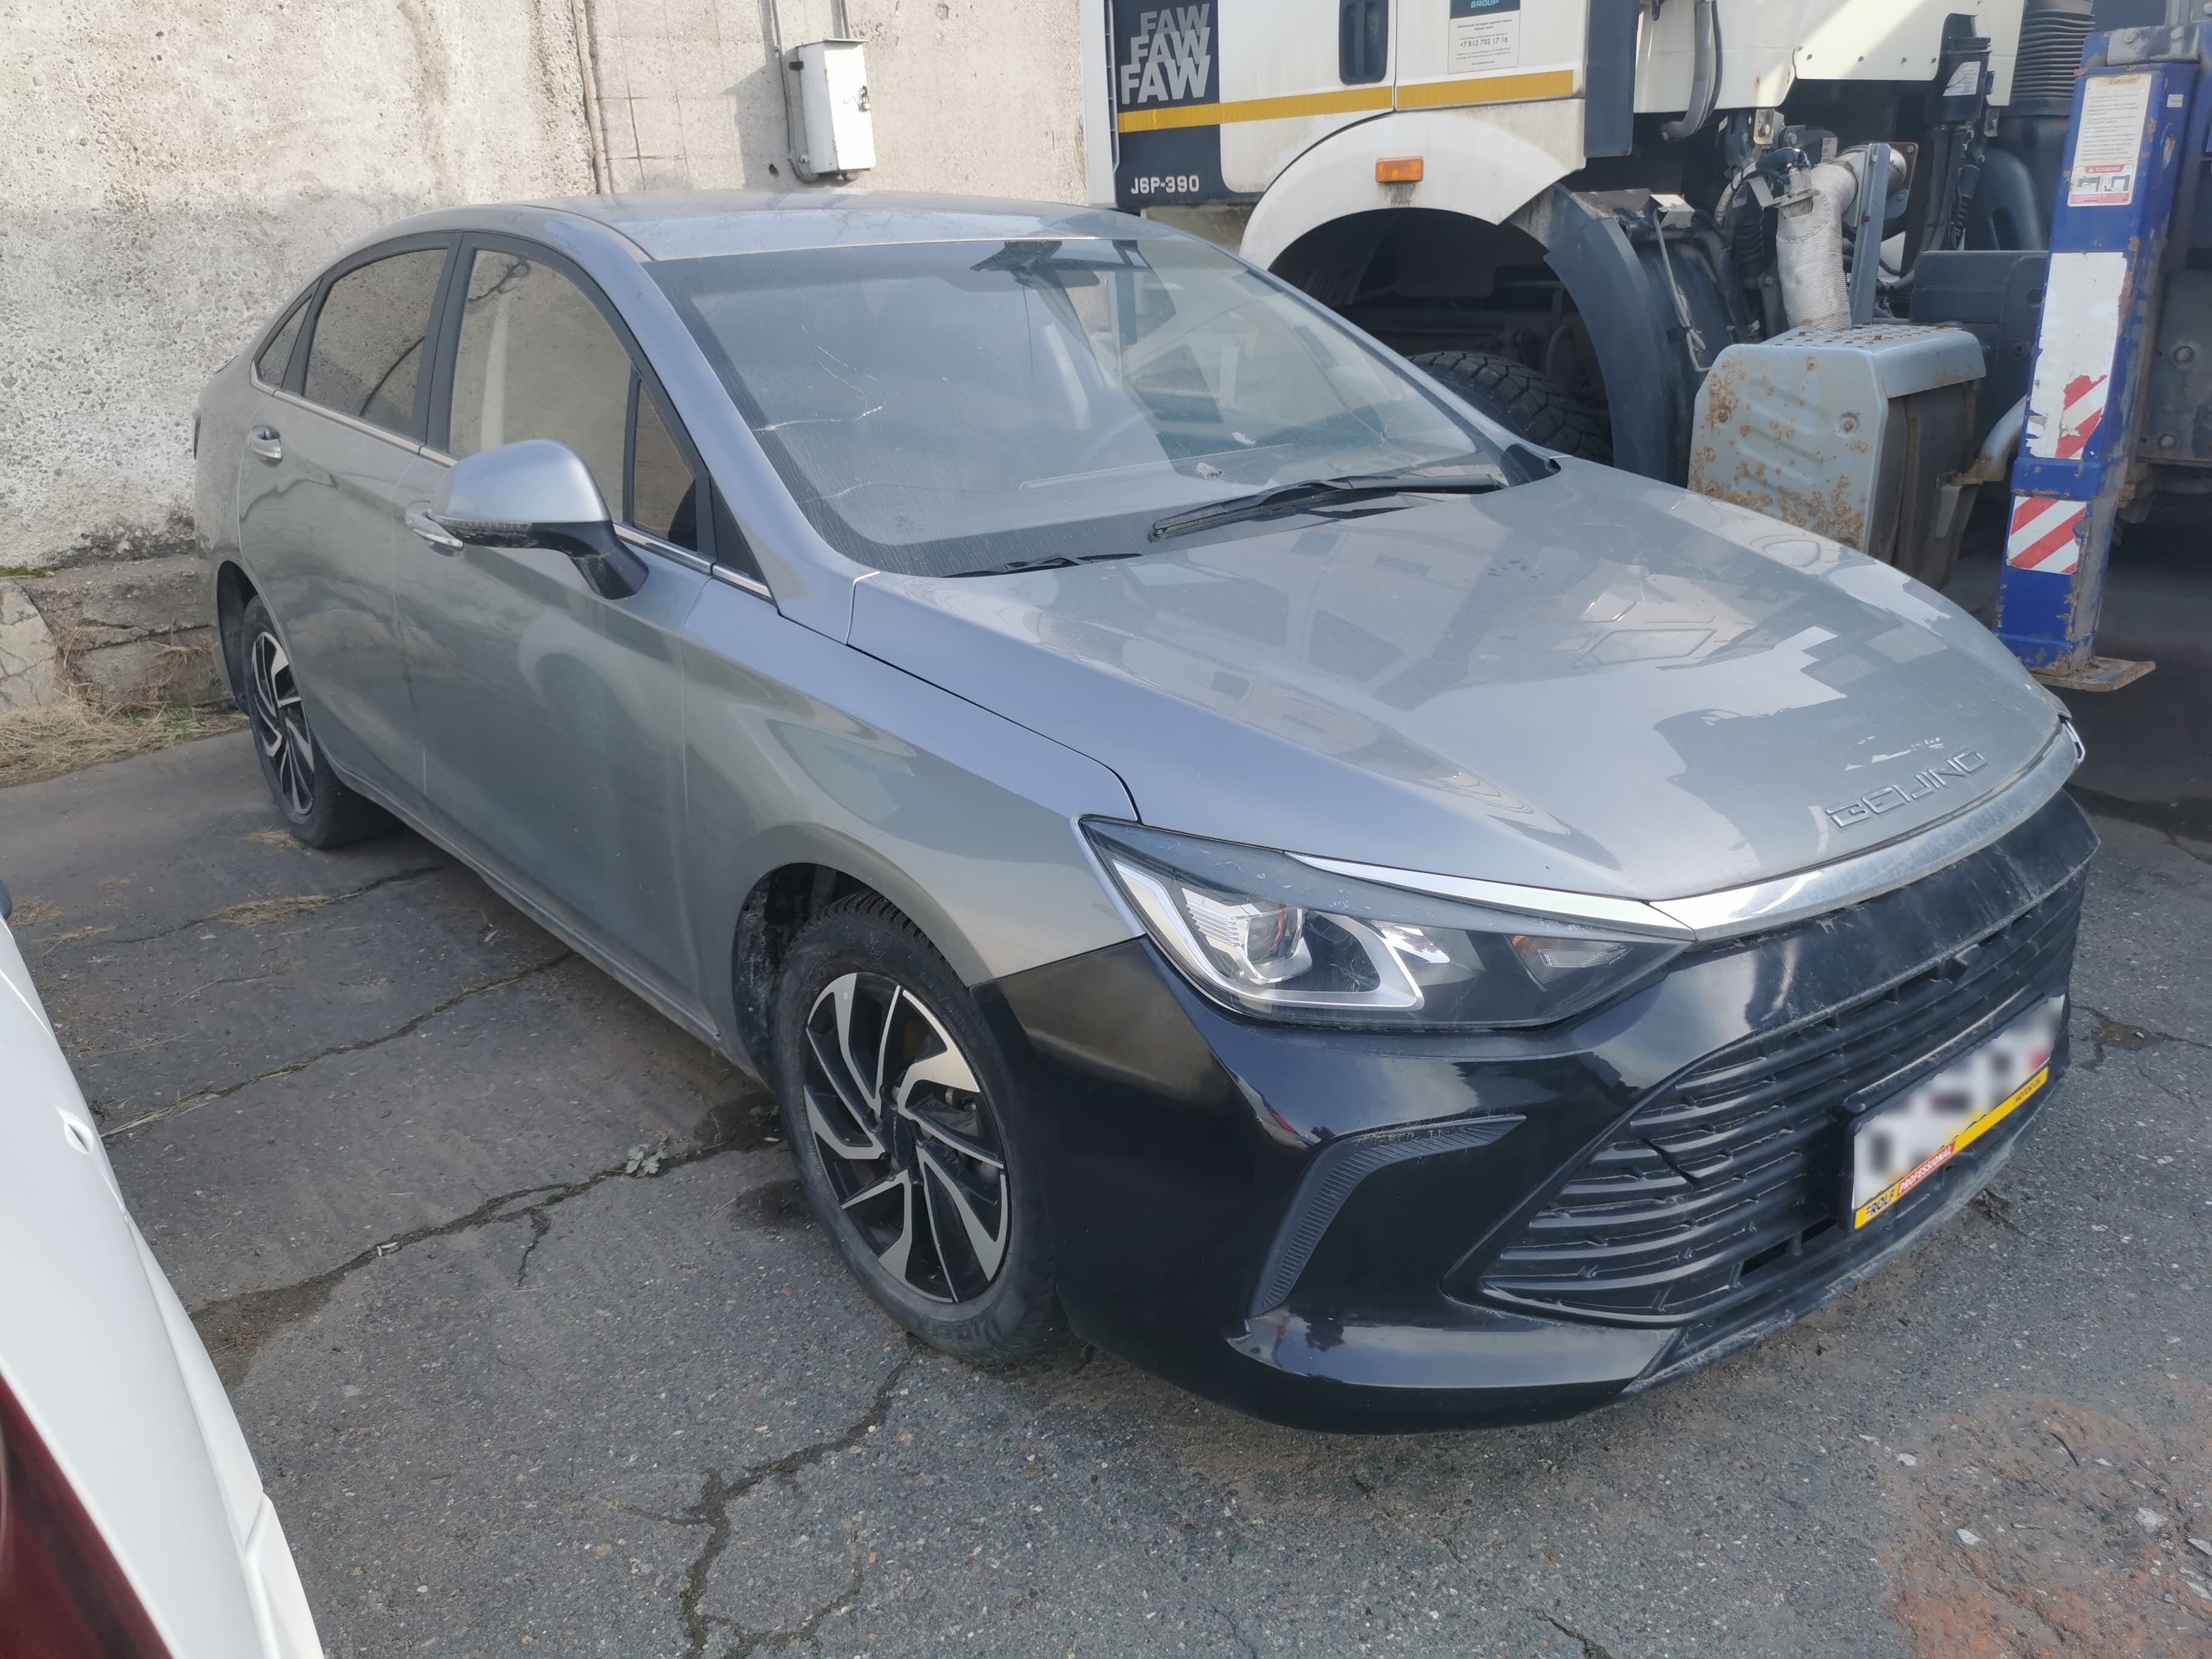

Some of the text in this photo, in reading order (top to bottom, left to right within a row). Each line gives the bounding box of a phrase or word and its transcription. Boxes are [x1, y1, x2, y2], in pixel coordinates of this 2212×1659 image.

[1140, 3, 1210, 37] FAW
[1130, 27, 1211, 66] FAW
[1121, 55, 1211, 105] FAW
[1131, 175, 1199, 194] J6P-390
[1825, 746, 1988, 828] BEIJING
[1898, 1144, 1952, 1194] PROFESSIONAL
